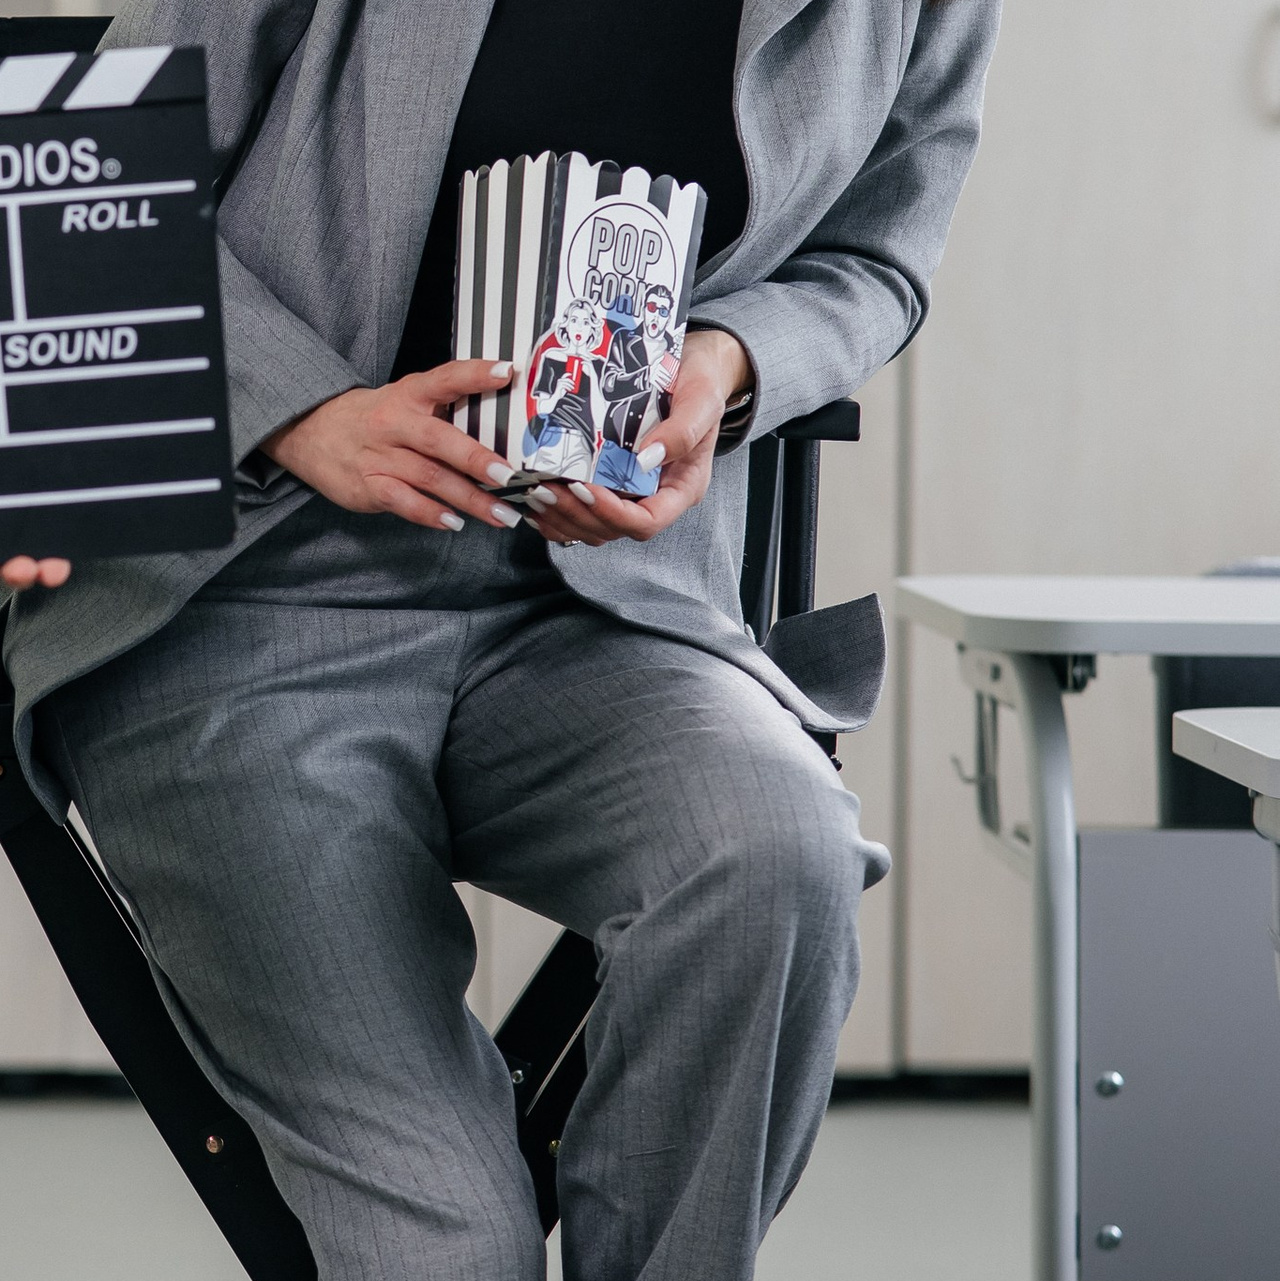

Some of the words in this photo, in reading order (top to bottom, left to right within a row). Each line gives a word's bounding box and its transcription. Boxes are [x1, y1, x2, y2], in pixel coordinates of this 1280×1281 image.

[62, 200, 158, 233] ROLL
[588, 216, 663, 280] POP
[4, 327, 137, 368] SOUND
